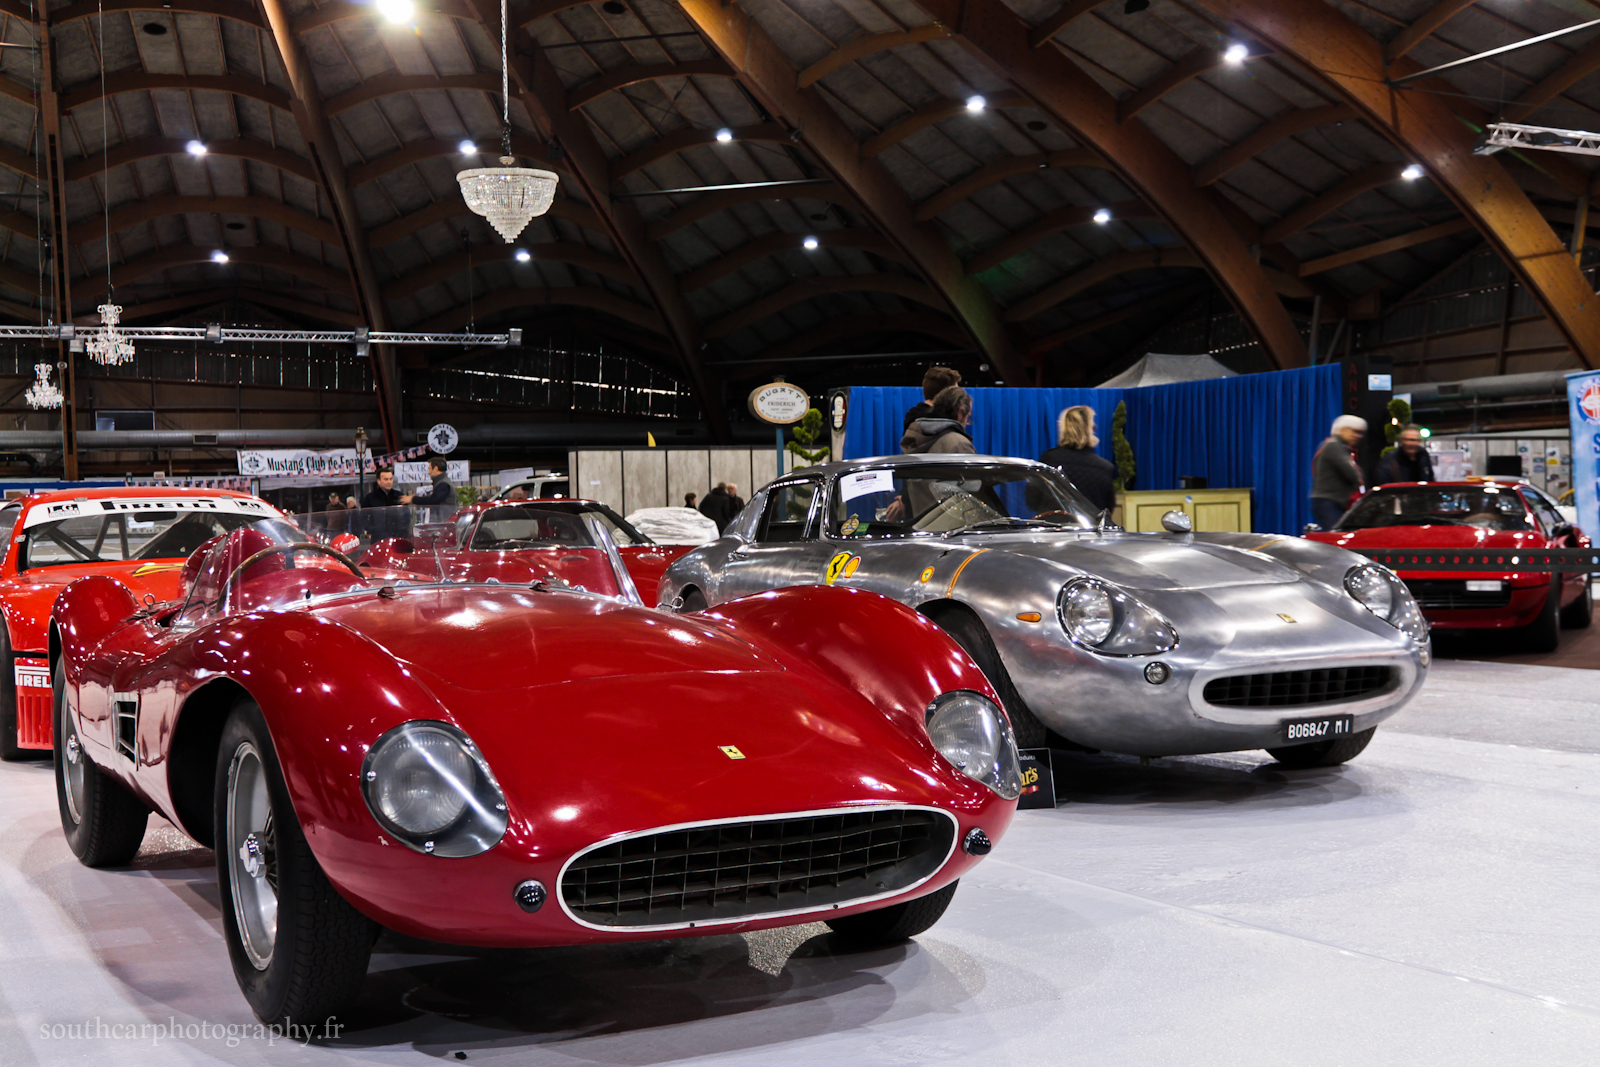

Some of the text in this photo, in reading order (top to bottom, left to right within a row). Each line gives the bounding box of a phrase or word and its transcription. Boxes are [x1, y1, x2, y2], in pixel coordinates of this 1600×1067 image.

[759, 387, 805, 403] BUGATTI
[431, 424, 456, 435] MUSTANG
[267, 457, 304, 473] Mustang
[306, 456, 325, 470] Club
[328, 457, 338, 470] de
[340, 456, 370, 469] Frane
[402, 463, 414, 472] LA
[402, 473, 462, 482] UNIVELE
[100, 499, 217, 510] PIRELLI
[15, 665, 52, 688] PIREL
[1288, 721, 1330, 739] B06847
